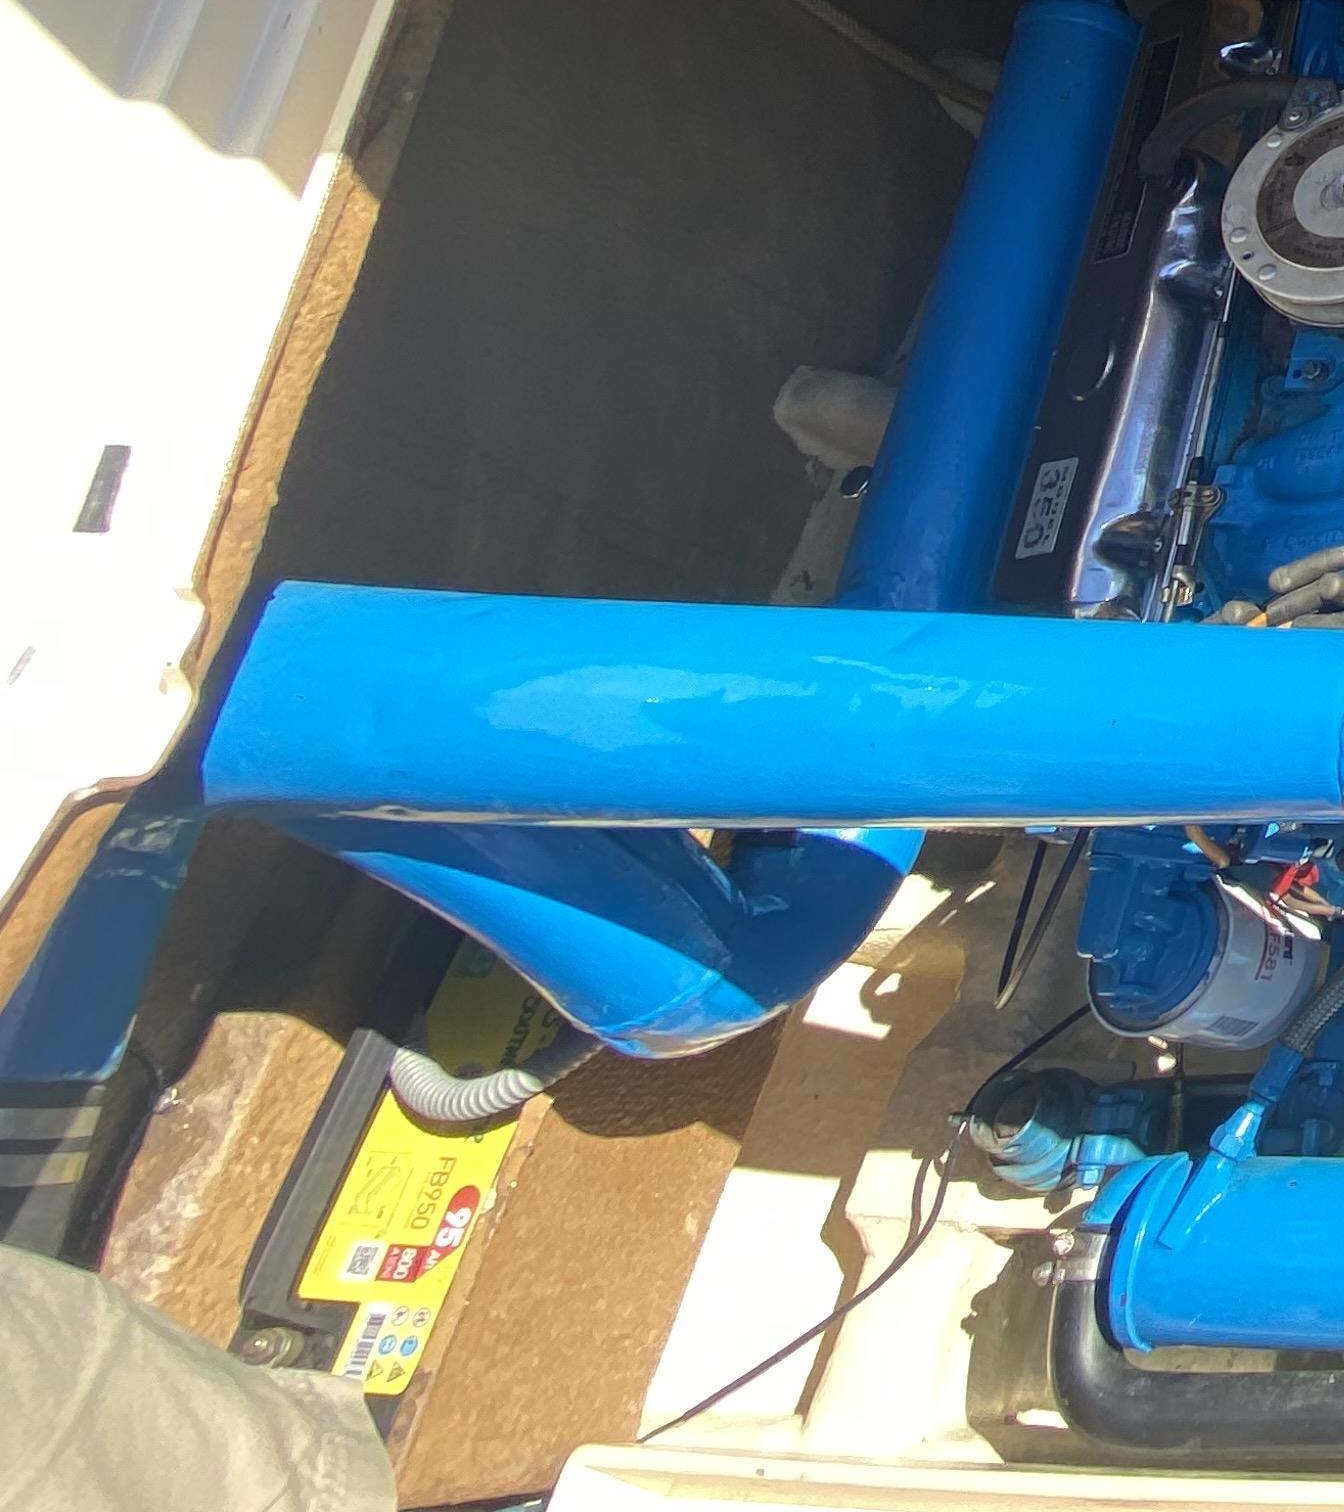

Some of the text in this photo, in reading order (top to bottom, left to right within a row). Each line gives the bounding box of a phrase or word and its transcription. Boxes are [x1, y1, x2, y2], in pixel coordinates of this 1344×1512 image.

[410, 1156, 458, 1230] FB950
[434, 1207, 473, 1248] 95
[392, 1247, 418, 1280] 800
